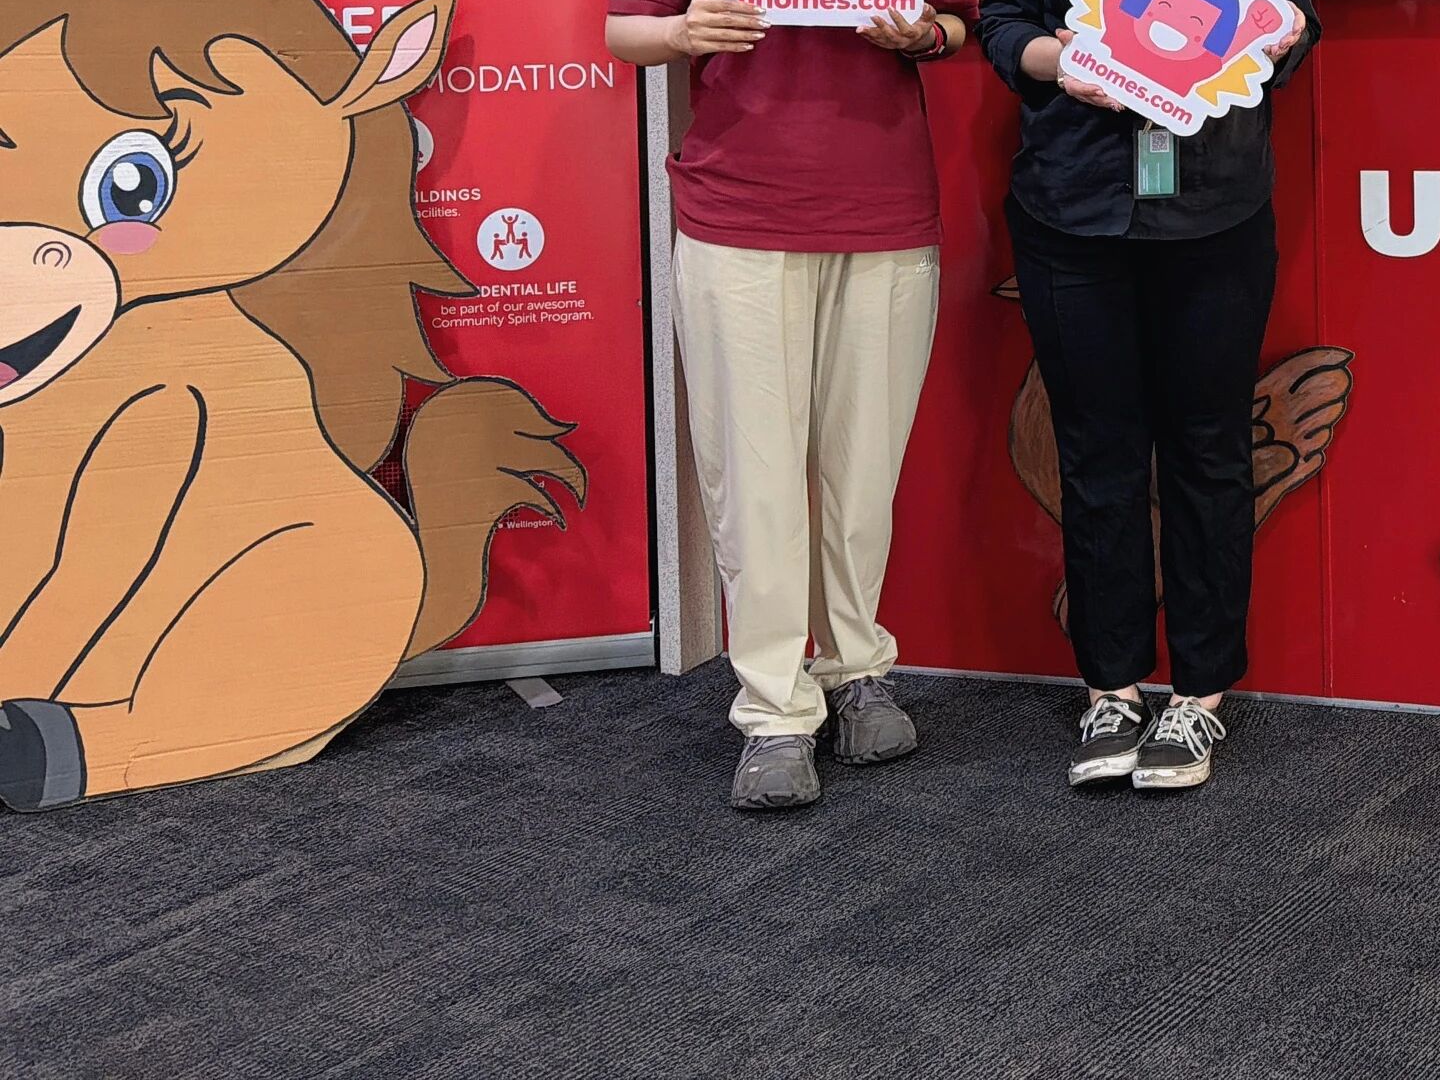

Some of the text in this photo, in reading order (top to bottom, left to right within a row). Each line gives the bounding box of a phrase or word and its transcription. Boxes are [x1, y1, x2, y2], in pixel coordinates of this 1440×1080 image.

[1071, 49, 1194, 125] uhomes.com
[415, 188, 481, 203] ILDINGS
[416, 206, 461, 218] acilities.
[478, 281, 577, 297] DENTIAL LIFE
[441, 299, 585, 316] be part of our awesome
[432, 311, 595, 328] Community Spirit Program.
[507, 520, 553, 529] Wellington
